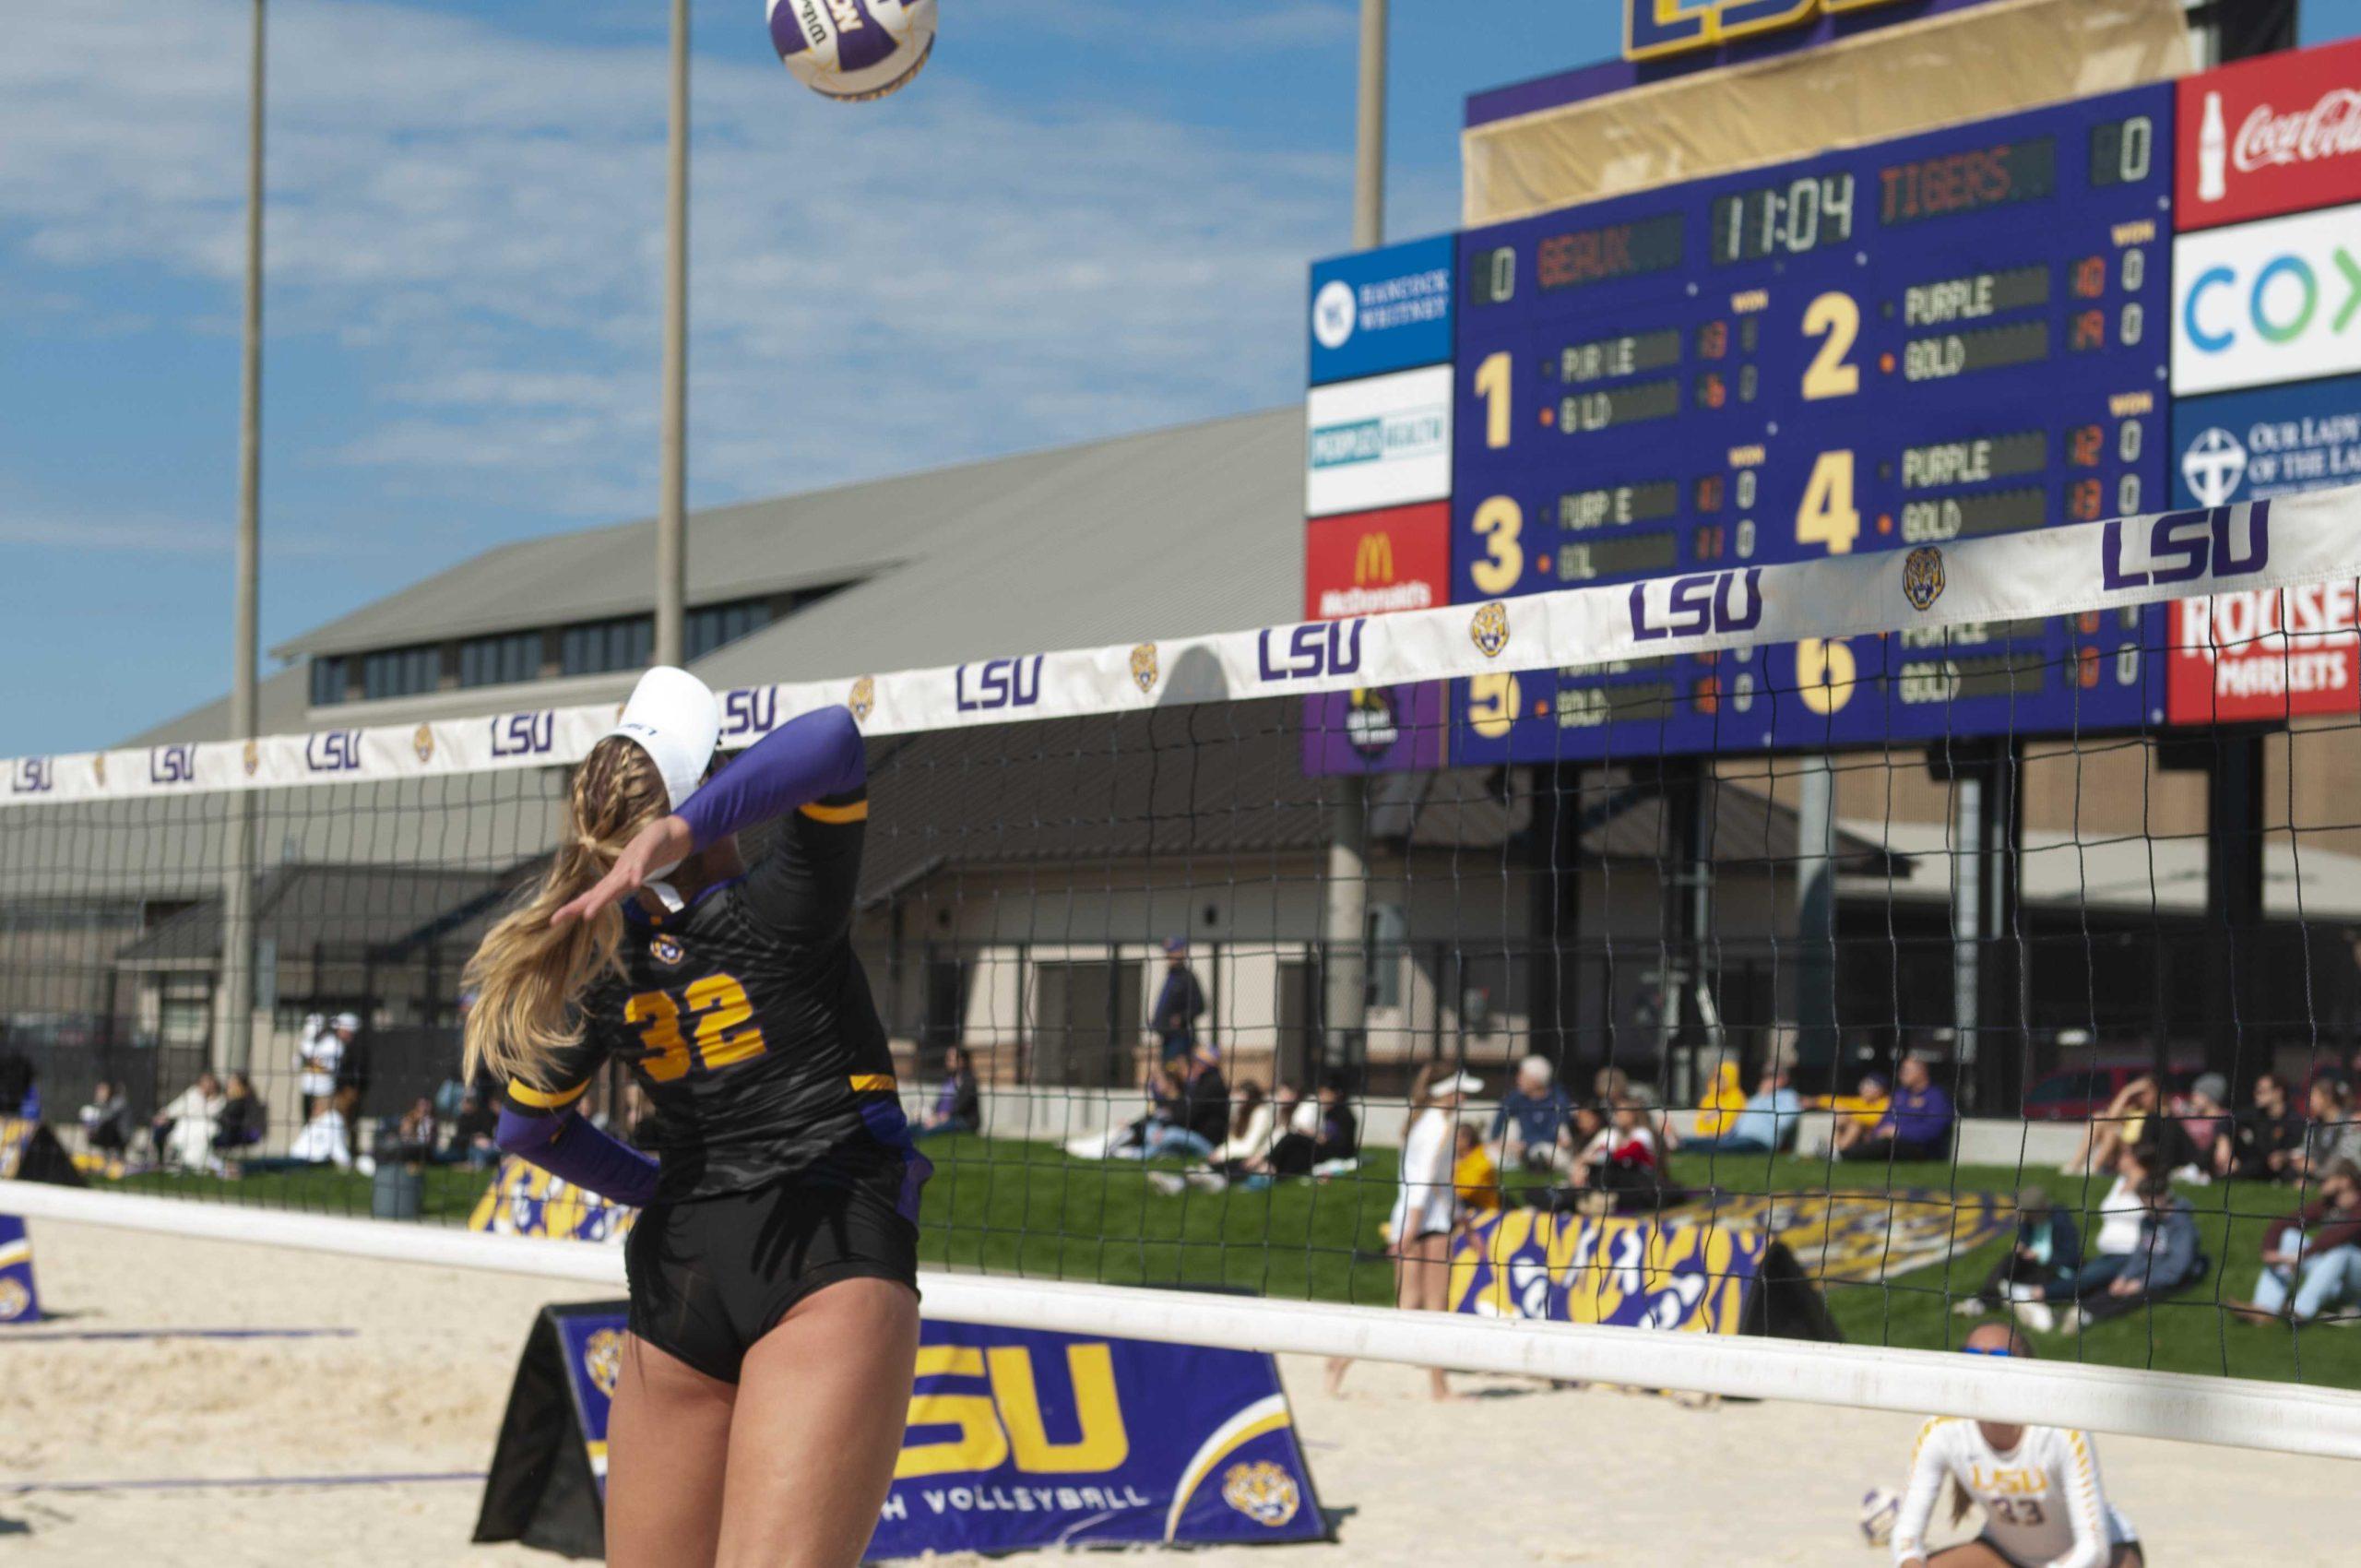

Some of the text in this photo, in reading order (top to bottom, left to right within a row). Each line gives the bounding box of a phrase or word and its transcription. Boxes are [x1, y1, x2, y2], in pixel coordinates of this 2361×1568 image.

[2120, 116, 2152, 182] 0
[1879, 145, 2011, 224] TIGERS
[1727, 172, 1854, 261] 11:04
[1491, 245, 1516, 303] 0
[2122, 248, 2144, 292] 0
[1904, 275, 1994, 327] PURPLE
[2120, 302, 2143, 347] 0
[1801, 291, 1860, 401] 2
[1904, 335, 1965, 382] GOLD
[1476, 351, 1512, 448] 1
[1560, 391, 1612, 434] GLD
[1902, 439, 1991, 489] PURPLE
[2120, 419, 2142, 463] 0
[2248, 422, 2298, 454] OUR
[1737, 469, 1757, 509] 0
[1796, 448, 1861, 553] 4
[1900, 498, 1962, 544] GOLD
[2118, 472, 2141, 516] 0
[1470, 495, 1523, 594] 3
[1736, 518, 1756, 559] 0
[2102, 499, 2271, 590] LSU
[1629, 566, 1762, 642] LSU
[1259, 619, 1366, 682] LSU
[2117, 642, 2139, 685] 0
[2216, 649, 2347, 699] MARKETS
[955, 653, 1044, 712] LSU
[491, 709, 554, 757] LSU
[719, 685, 777, 735] SU
[12, 757, 53, 793] LSU
[150, 742, 196, 783] LSU
[307, 729, 362, 772] LSU
[623, 971, 767, 1083] 32
[895, 1342, 1129, 1480] SU
[923, 1483, 1150, 1515] VOLLEYBALL
[1972, 1464, 2048, 1496] LSU
